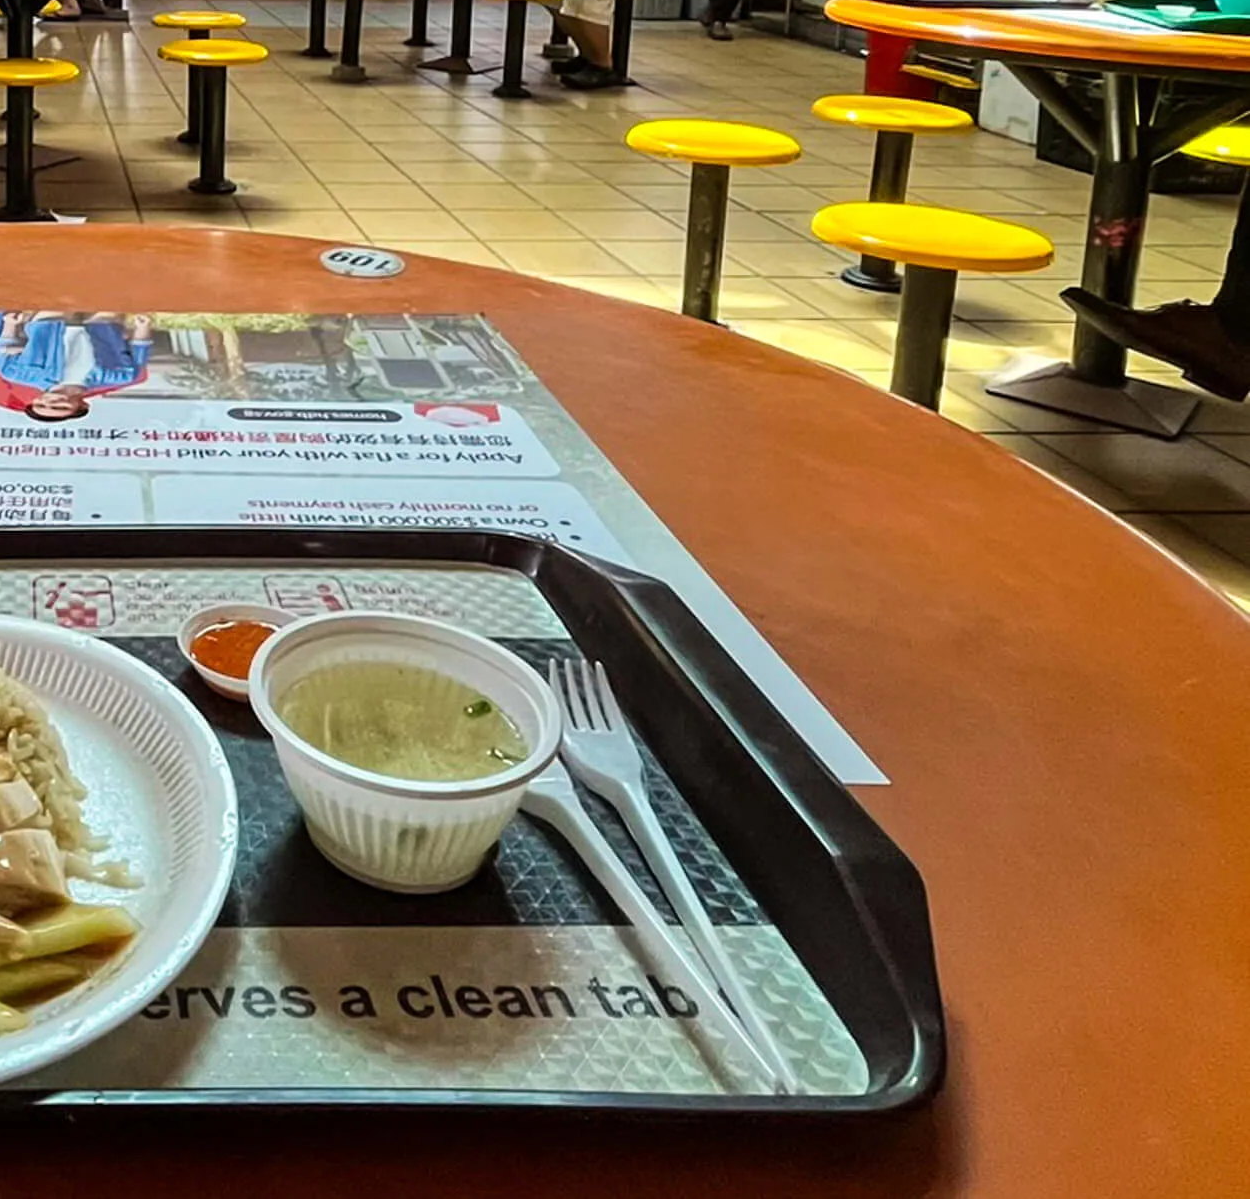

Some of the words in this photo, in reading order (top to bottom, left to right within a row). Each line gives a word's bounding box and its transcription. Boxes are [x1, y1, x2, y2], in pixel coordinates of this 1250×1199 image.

[69, 447, 109, 458] Flat
[116, 447, 171, 458] HDB
[177, 449, 231, 459] valid
[237, 448, 288, 458] your
[295, 451, 346, 461] with
[352, 452, 392, 462] flat
[416, 453, 451, 463] for
[456, 452, 523, 464] Apply
[247, 499, 344, 509] payments
[349, 502, 394, 512] cash
[399, 501, 482, 513] monthly
[487, 504, 512, 513] no
[519, 505, 538, 513] or
[238, 512, 285, 523] little
[289, 513, 333, 524] with
[341, 515, 374, 526] flat
[495, 518, 548, 528] Own
[141, 985, 316, 1020] erves
[338, 984, 377, 1018] a
[397, 974, 577, 1018] clean
[587, 974, 700, 1019] tab
